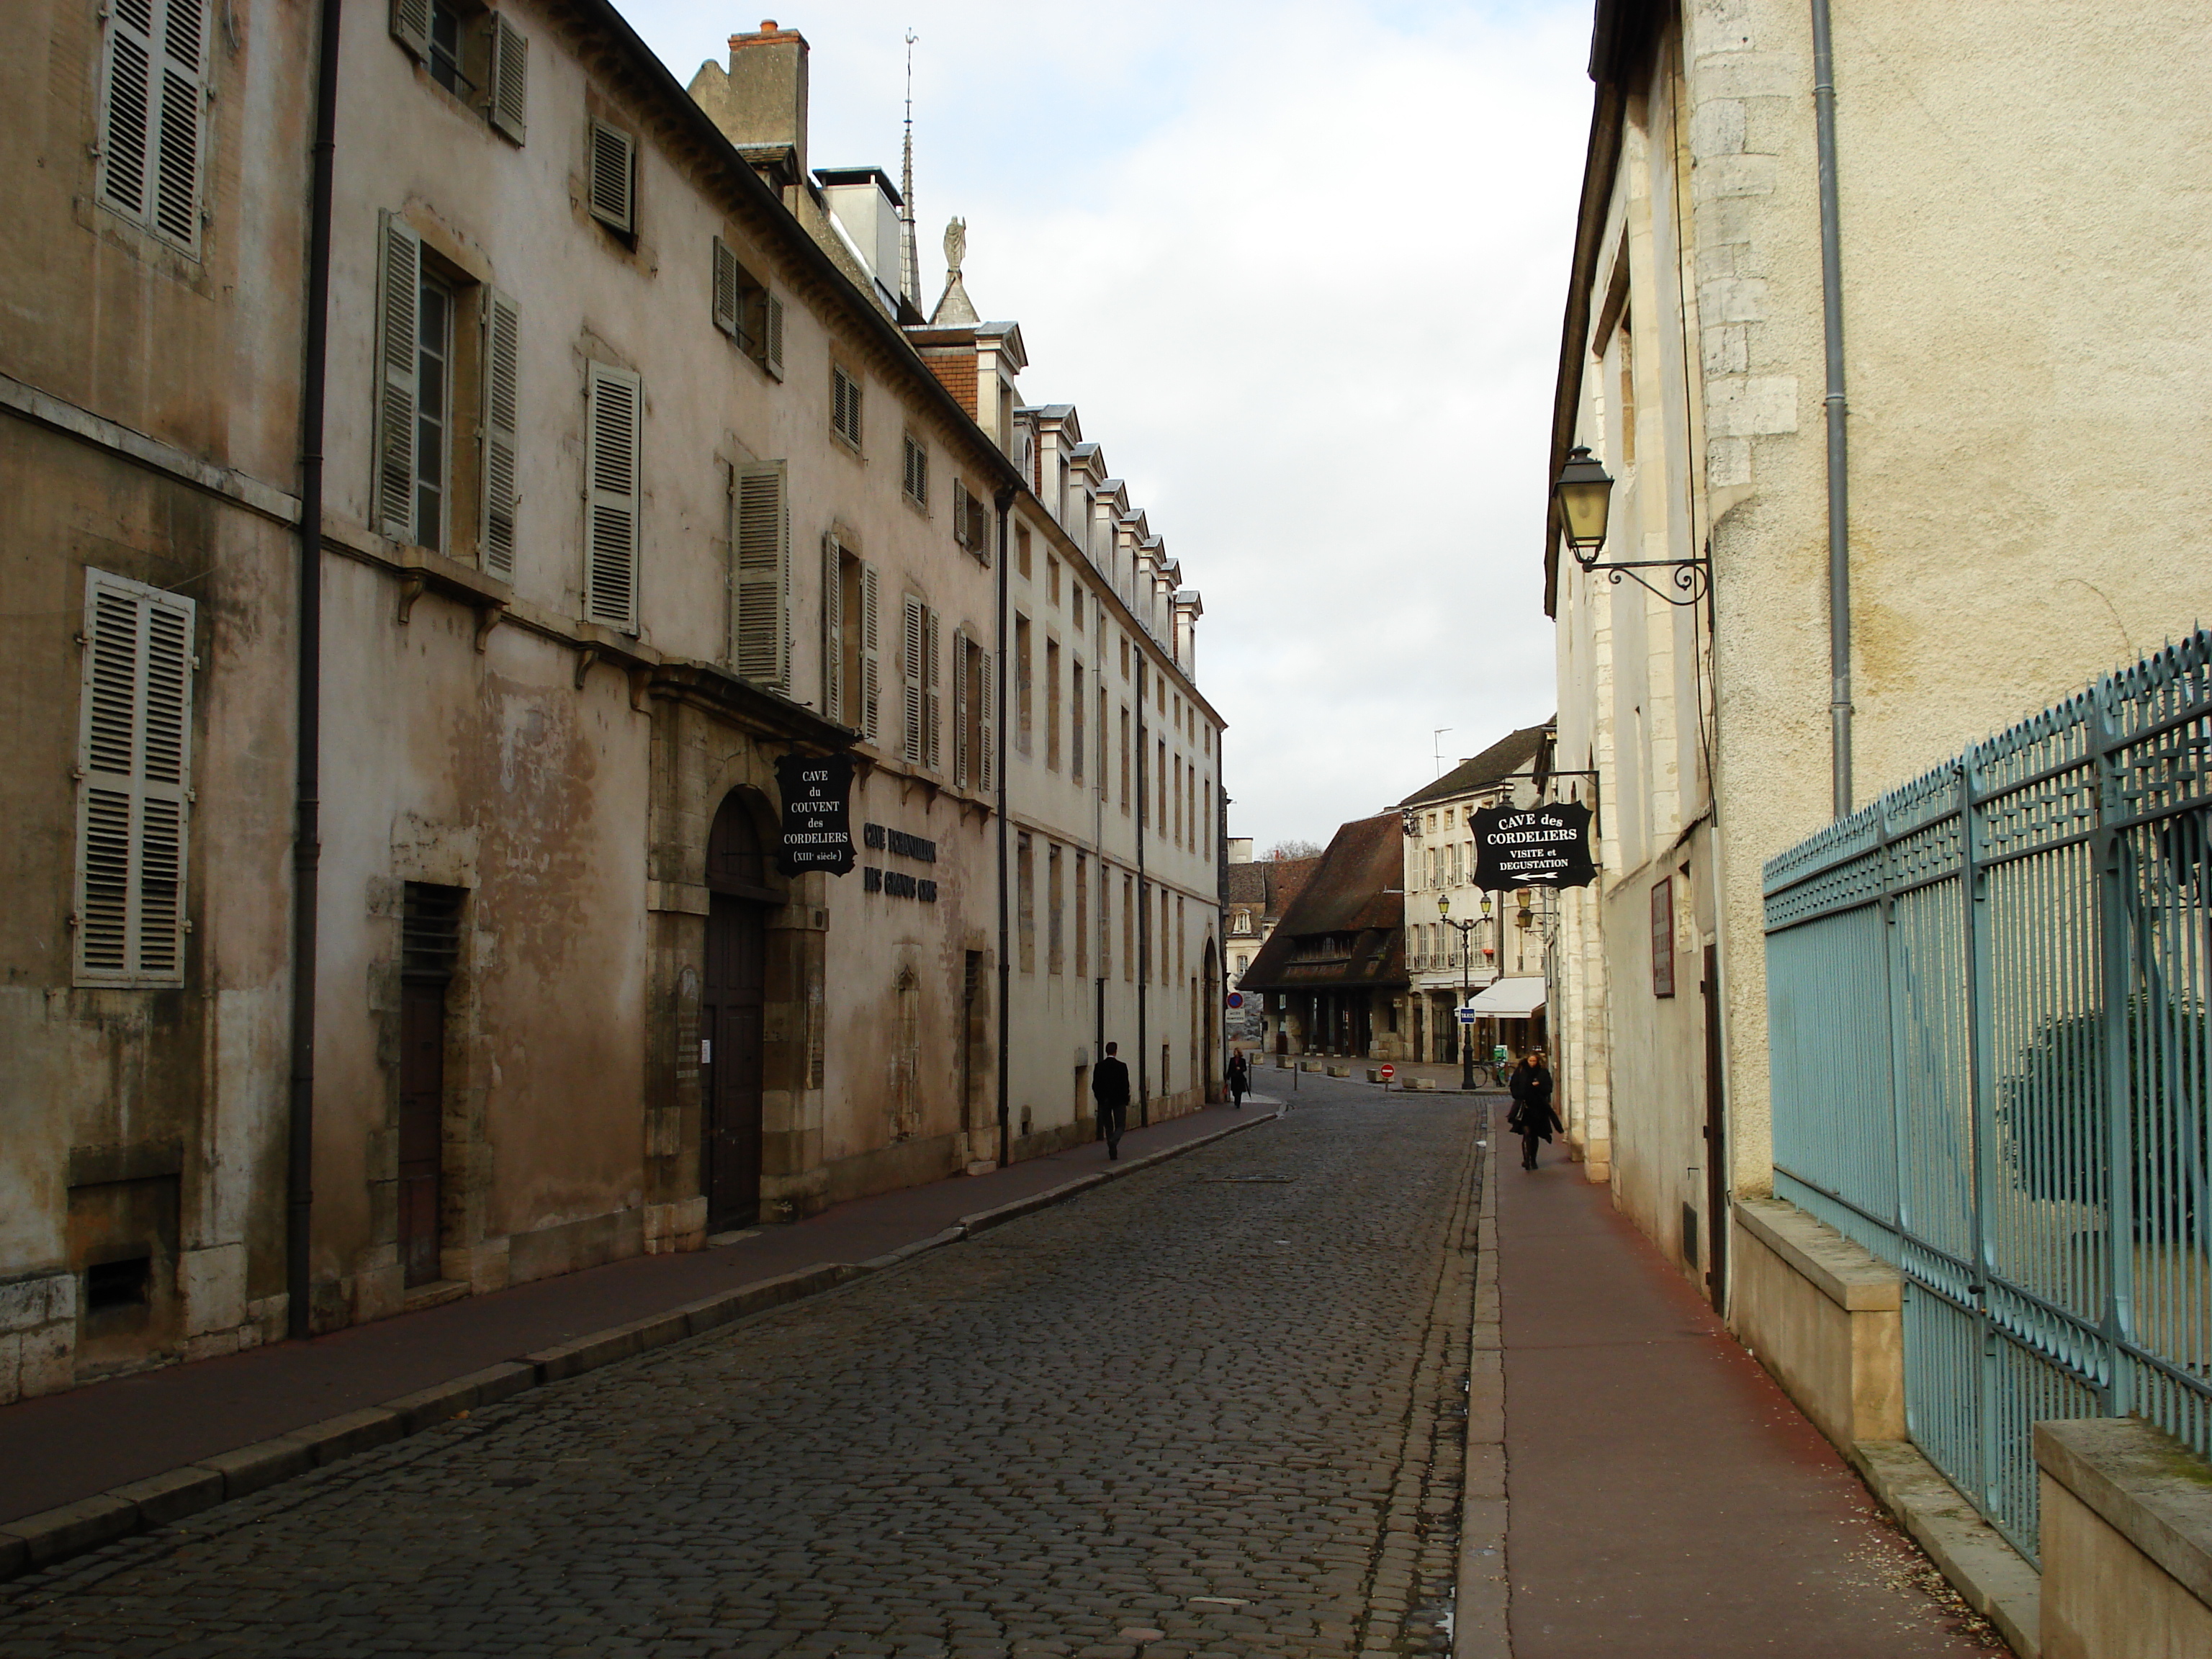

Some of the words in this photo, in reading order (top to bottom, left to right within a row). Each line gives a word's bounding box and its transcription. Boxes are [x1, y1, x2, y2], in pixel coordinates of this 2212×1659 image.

[802, 770, 828, 781] CAVE
[809, 786, 821, 796] du
[791, 801, 840, 813] COUVENT
[808, 817, 823, 828] des
[1498, 813, 1536, 830] CAVE
[1540, 814, 1563, 827] des
[783, 832, 848, 845] CORDELIERS
[863, 822, 886, 850] CAVE
[1487, 829, 1578, 845] CORDELIERS
[1510, 849, 1545, 859] VISITE
[1547, 848, 1557, 857] et
[1499, 858, 1569, 871] DEGUSTATION
